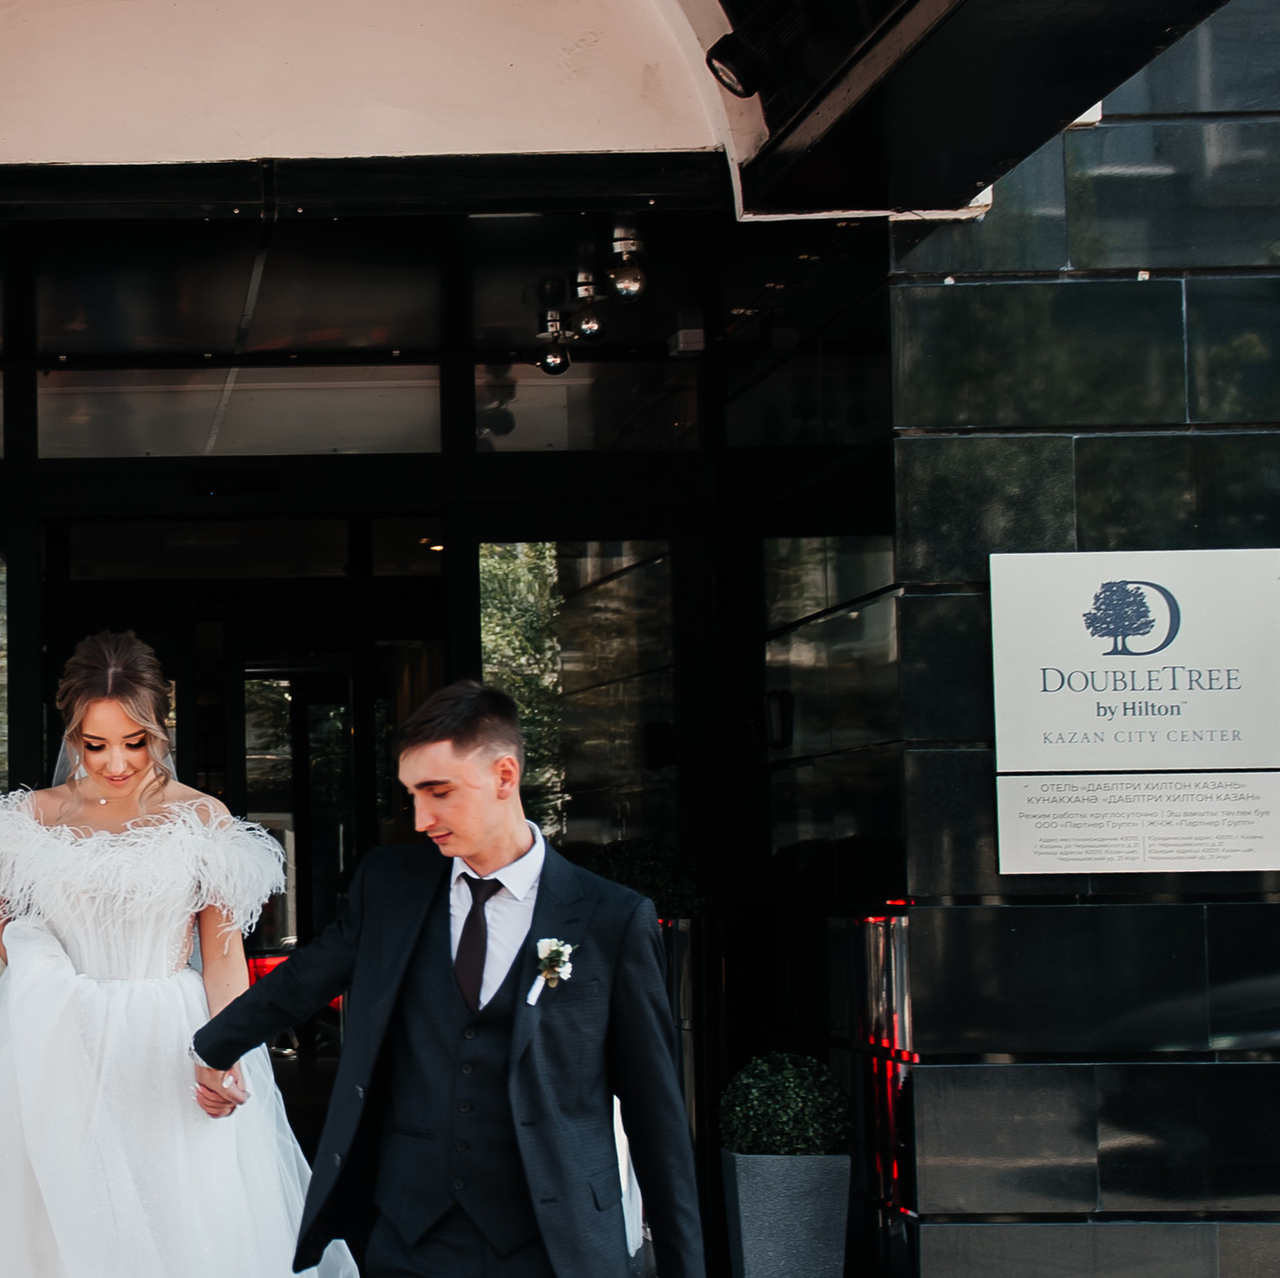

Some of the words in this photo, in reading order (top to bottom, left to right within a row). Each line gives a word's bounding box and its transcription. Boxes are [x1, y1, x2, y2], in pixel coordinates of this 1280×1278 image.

[1096, 701, 1118, 721] by
[1122, 700, 1181, 717] Hilton
[1042, 731, 1105, 744] KAZAN
[1114, 730, 1159, 743] CITY
[1166, 729, 1243, 742] CENTER
[1040, 783, 1079, 793] ОТЕЛЬ
[1143, 781, 1192, 791] ХИЛТОН
[1165, 793, 1213, 803] ХИЛТОН
